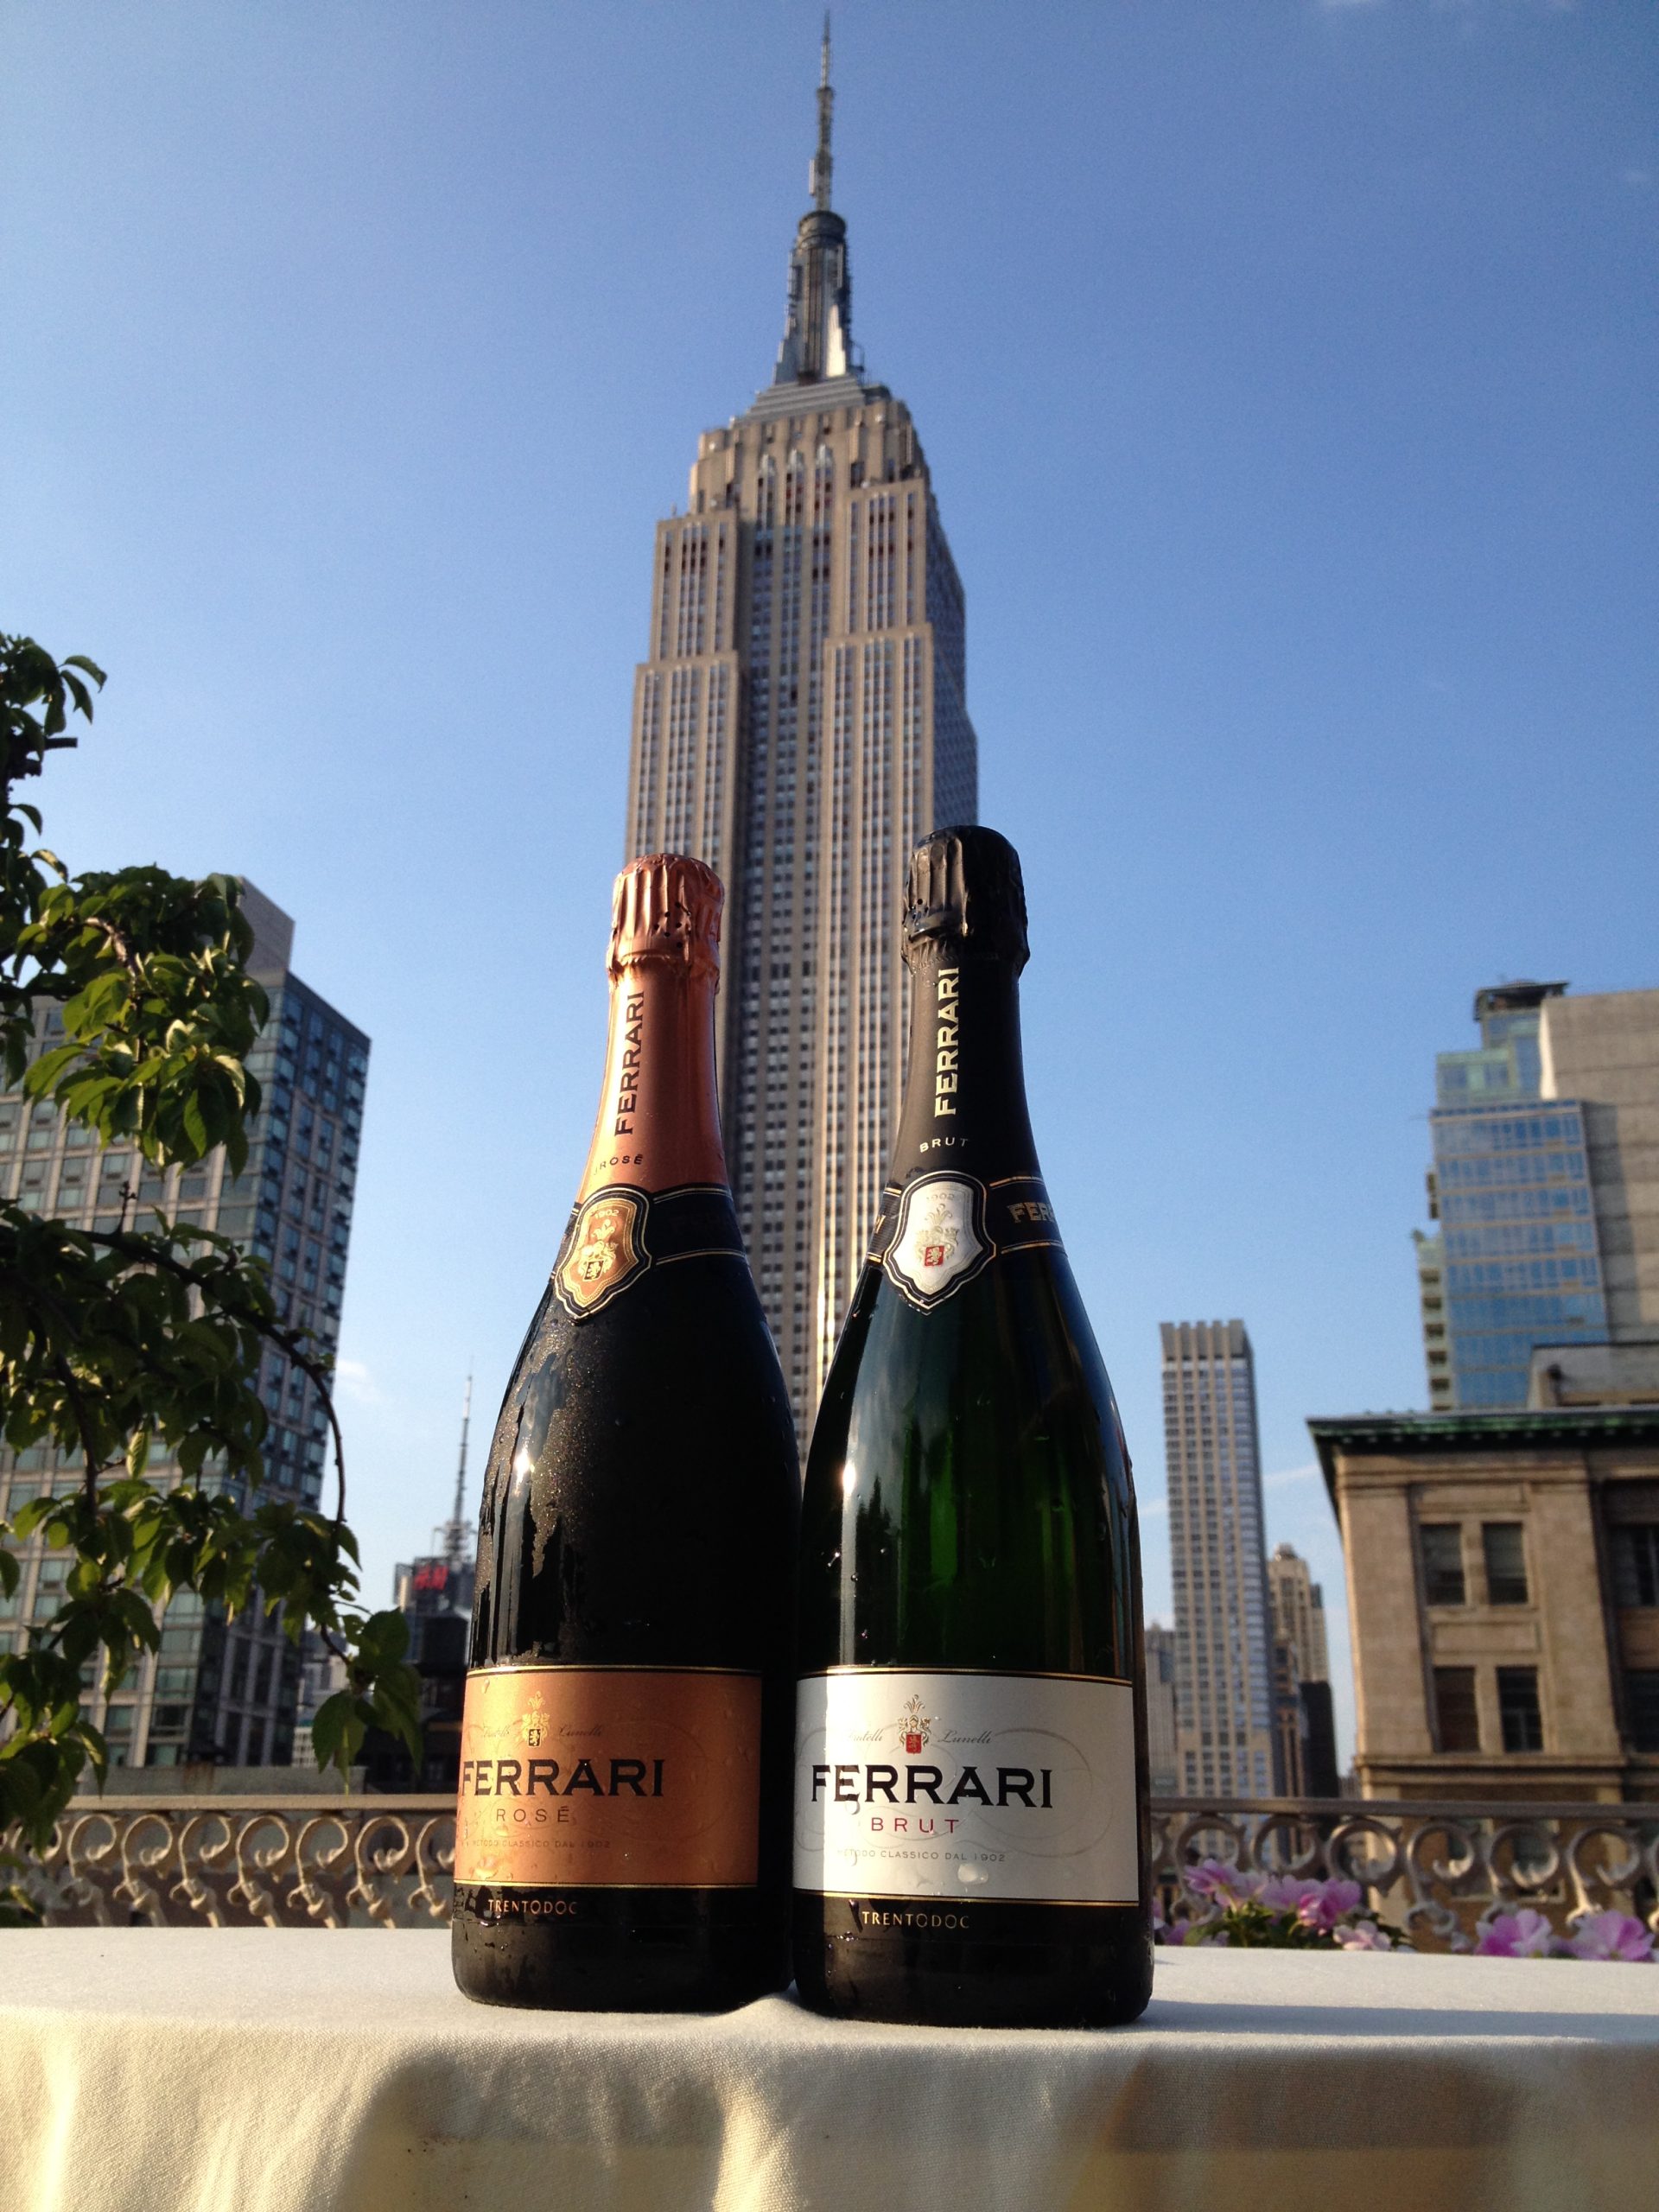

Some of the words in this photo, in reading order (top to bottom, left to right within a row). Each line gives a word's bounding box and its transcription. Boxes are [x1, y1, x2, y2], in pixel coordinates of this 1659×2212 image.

[934, 966, 960, 1118] FERRARI
[614, 991, 645, 1136] FERRARI
[919, 1137, 969, 1153] BRUT
[938, 1728, 992, 1745] Lunelli
[461, 1758, 664, 1796] FERRARI
[811, 1764, 1053, 1808] FERRARI
[496, 1806, 569, 1822] ROSÉ
[871, 1817, 959, 1834] BRUT
[502, 1840, 550, 1848] CLASSICO
[880, 1850, 939, 1859] CLASSICO
[974, 1853, 1006, 1862] 1902
[488, 1898, 578, 1916] TRENTODOC
[861, 1910, 970, 1929] TRENTODOC
